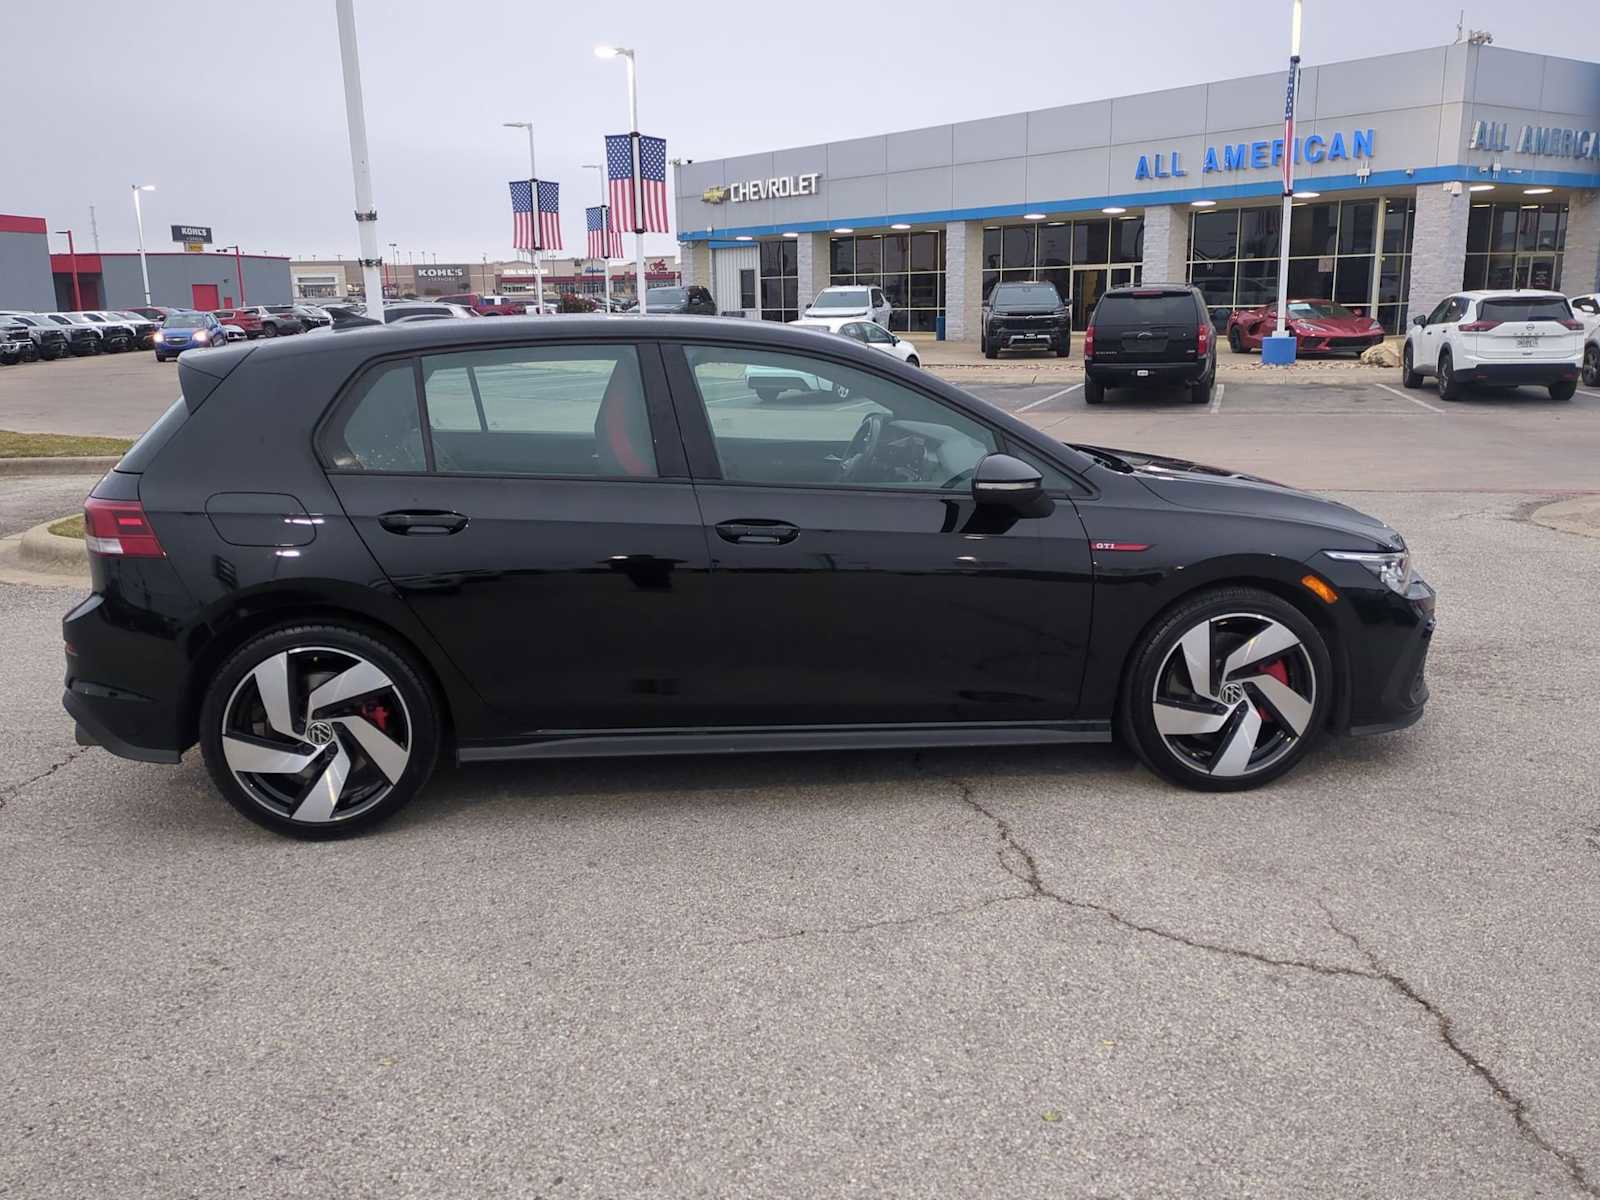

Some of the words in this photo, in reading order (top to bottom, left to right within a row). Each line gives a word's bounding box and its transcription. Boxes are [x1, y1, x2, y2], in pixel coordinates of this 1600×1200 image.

[1469, 120, 1509, 152] ALL
[1135, 151, 1187, 181] ALL
[1202, 128, 1376, 173] AMERICAN
[730, 172, 819, 202] CHEVROLET
[418, 268, 463, 277] KOHL'S
